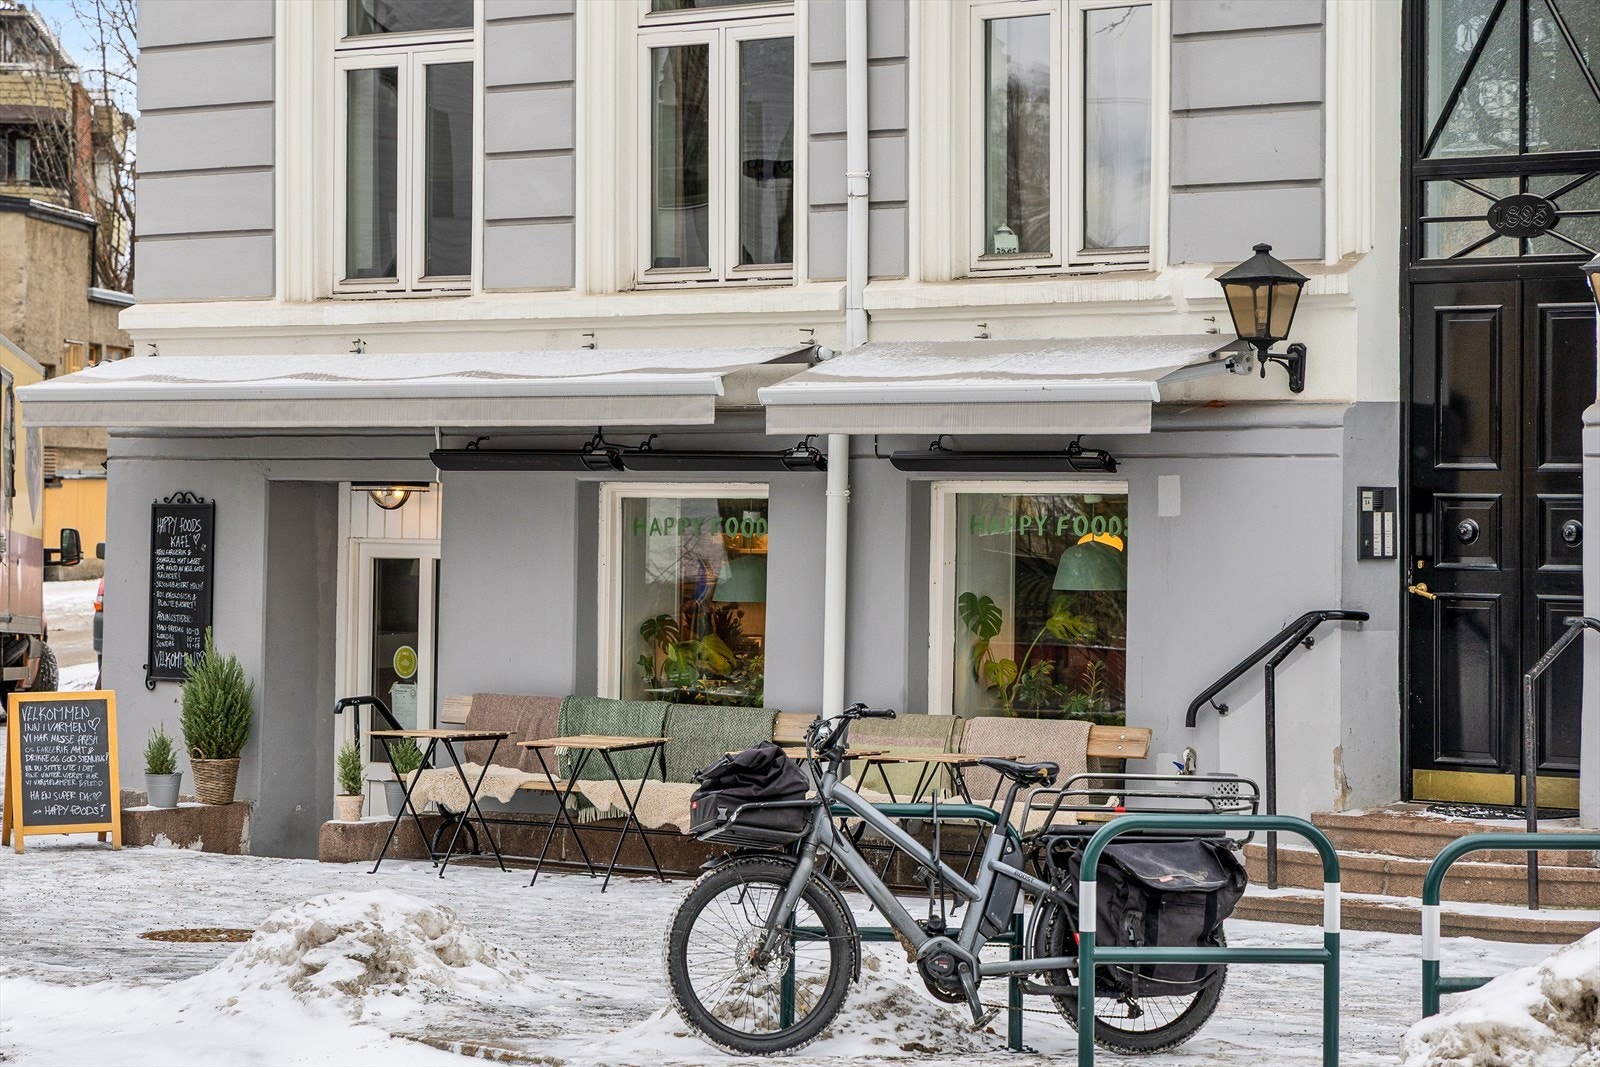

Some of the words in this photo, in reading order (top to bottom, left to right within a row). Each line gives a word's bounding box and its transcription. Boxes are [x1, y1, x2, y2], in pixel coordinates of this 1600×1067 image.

[1493, 204, 1549, 229] 1895
[156, 516, 177, 535] HAPPY
[179, 517, 202, 533] FOODS
[632, 516, 701, 537] HAPPY
[711, 515, 768, 538] FOOD
[970, 514, 1047, 536] HAPPY
[22, 706, 90, 721] VELKOMMEN
[24, 723, 40, 732] INN
[47, 722, 87, 733] VARMEN
[23, 733, 32, 743] VI
[33, 733, 48, 741] HAR
[51, 734, 74, 745] MASSE
[77, 734, 98, 746] FRESH
[37, 746, 69, 754] FARGERIK
[25, 754, 50, 763] DRIKKE
[62, 755, 77, 763] GOD
[82, 764, 95, 772] DET
[30, 791, 40, 800] HA
[41, 791, 52, 800] EN
[53, 791, 77, 801] SUPER
[79, 792, 93, 801] DAG
[44, 804, 70, 816] HAPPY
